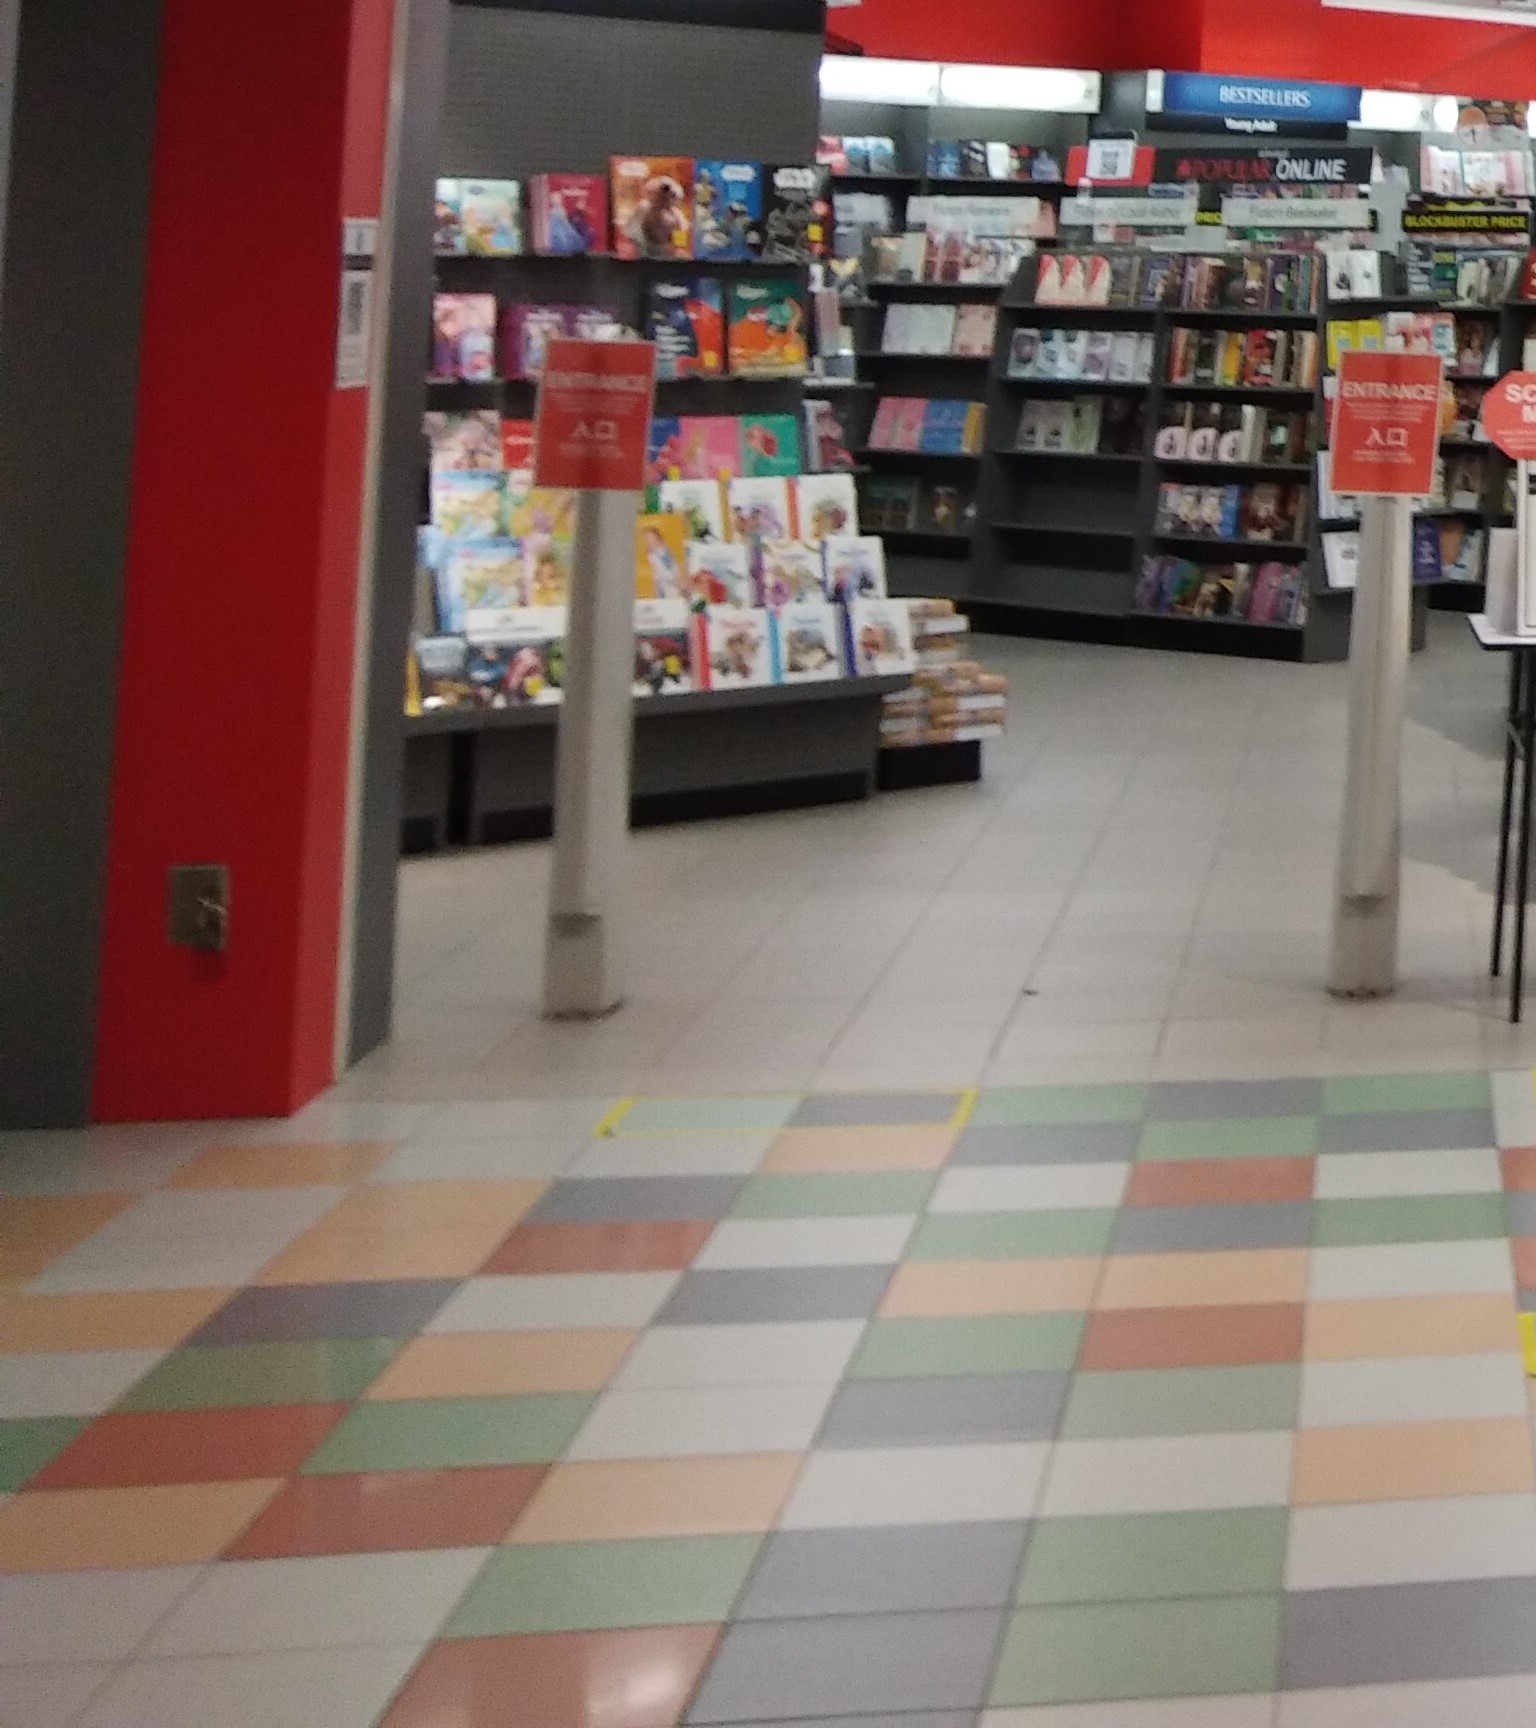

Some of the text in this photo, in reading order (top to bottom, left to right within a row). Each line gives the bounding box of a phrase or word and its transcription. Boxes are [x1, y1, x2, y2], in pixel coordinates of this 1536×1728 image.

[1219, 84, 1312, 109] BESTSELLERS
[1191, 157, 1348, 181] POPULAR ONLINE
[1403, 214, 1527, 229] BLOCKBUSTER PRICE
[1342, 380, 1438, 402] ENTRANCE
[1364, 426, 1409, 448] 入口
